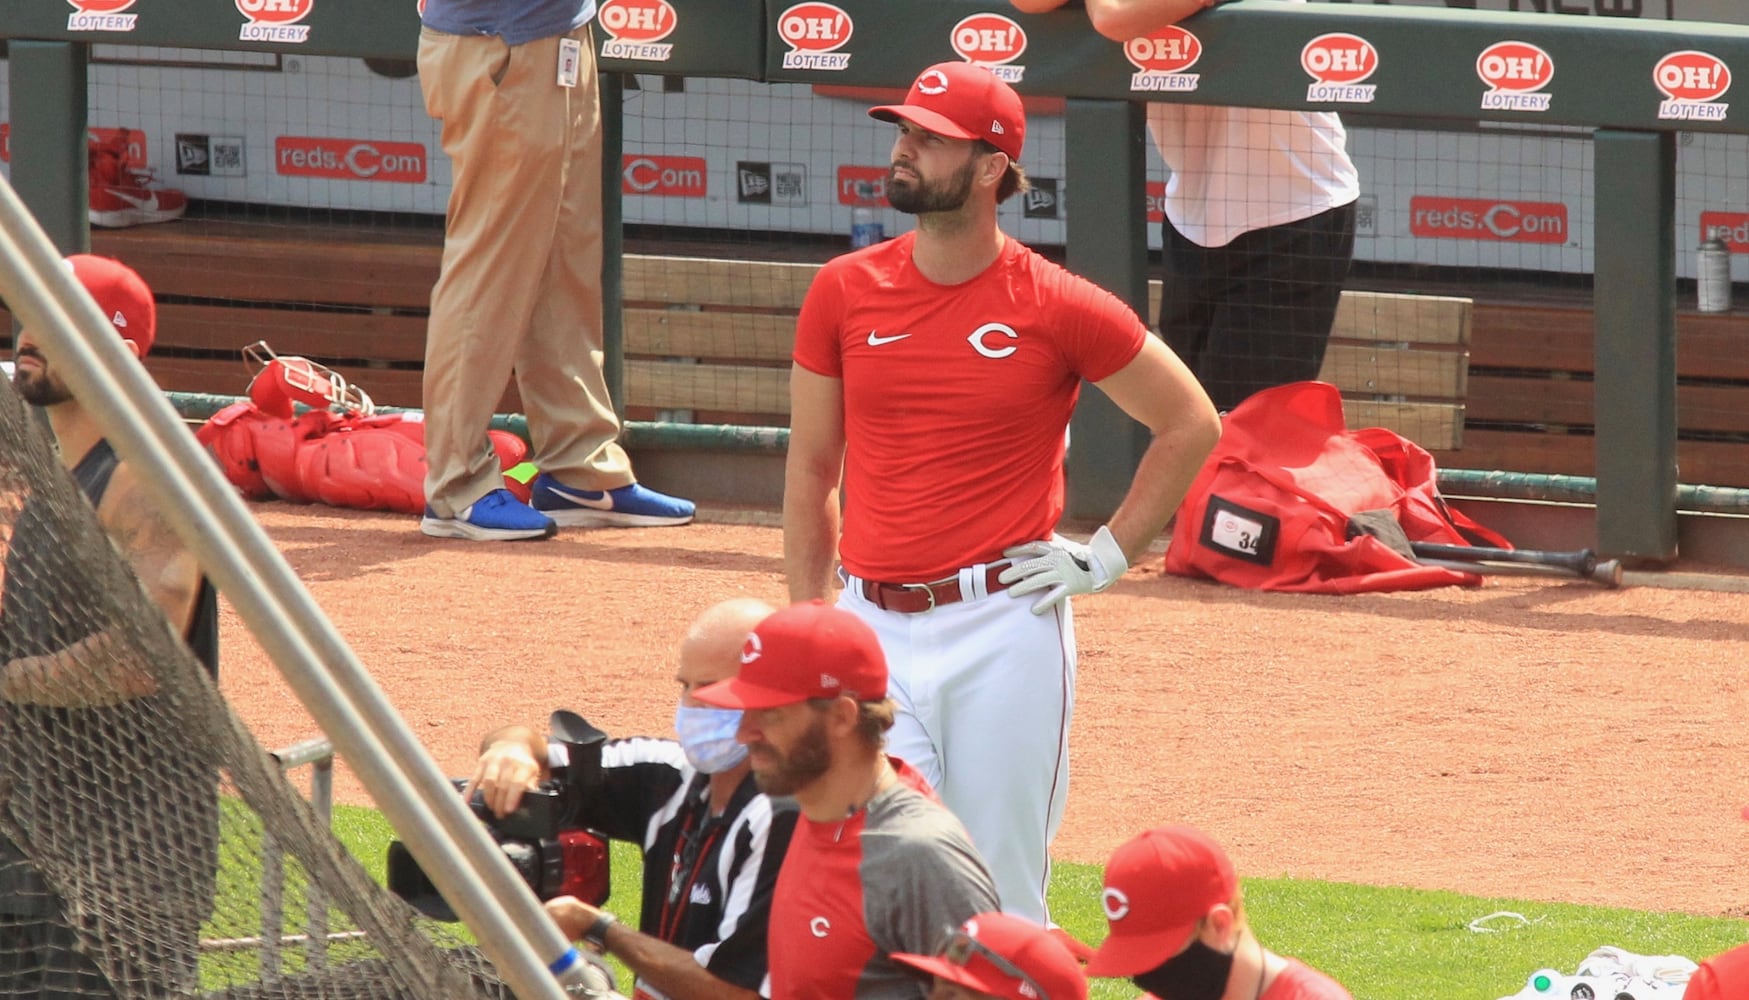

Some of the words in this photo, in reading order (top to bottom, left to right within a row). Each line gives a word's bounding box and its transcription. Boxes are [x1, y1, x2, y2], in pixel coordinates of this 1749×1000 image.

[70, 16, 133, 28] LOTTERY
[604, 5, 667, 31] OH!
[783, 14, 843, 40] OH!
[242, 27, 305, 39] LOTTERY
[957, 25, 1016, 52] OH!
[604, 44, 668, 58] LOTTERY
[1130, 35, 1191, 61] OH!
[1307, 45, 1368, 71] OH!
[785, 55, 846, 68] LOTTERY
[1482, 54, 1545, 80] OH!
[1133, 75, 1196, 89] LOTTERY
[1659, 63, 1722, 90] OH!
[1309, 86, 1372, 100] LOTTERY
[1484, 95, 1547, 109] LOTTERY
[1661, 104, 1725, 119] LOTTERY
[966, 322, 1019, 359] C
